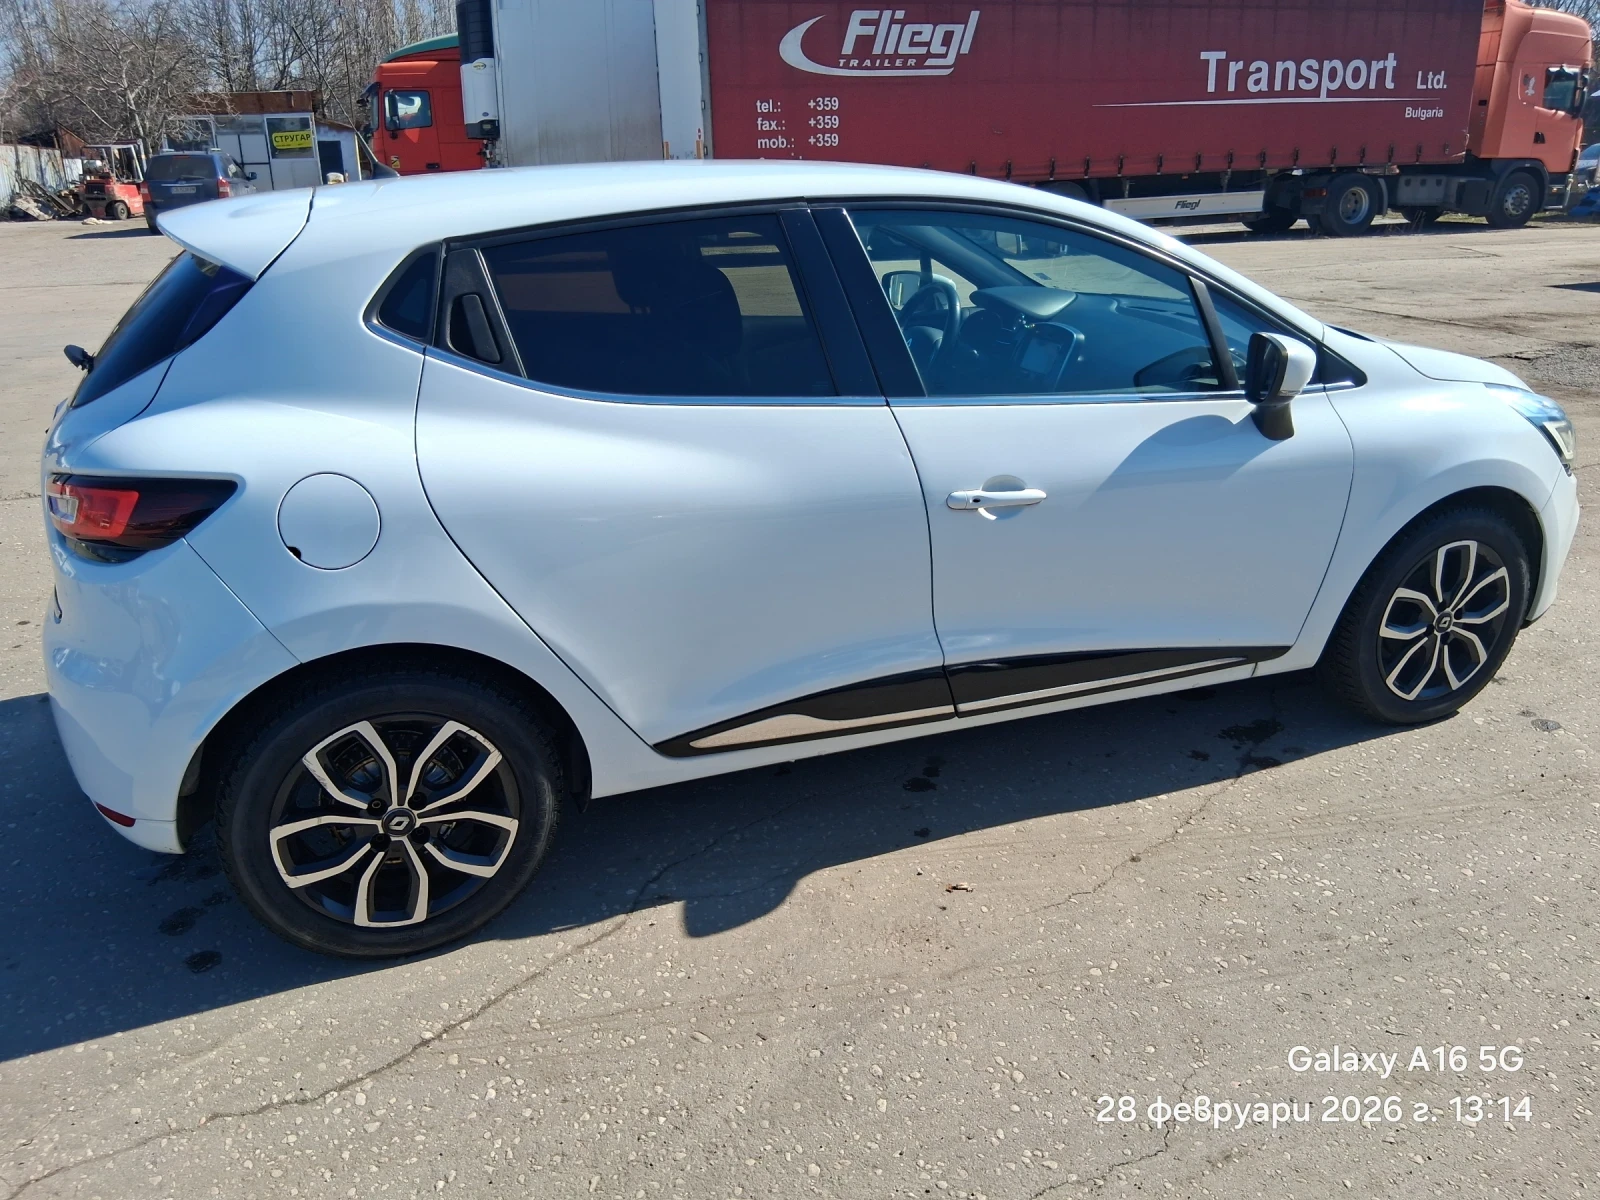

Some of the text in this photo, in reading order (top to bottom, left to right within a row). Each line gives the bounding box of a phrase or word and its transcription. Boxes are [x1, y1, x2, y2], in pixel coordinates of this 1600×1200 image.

[841, 10, 980, 66] Fliegl
[838, 58, 917, 67] TRAILER
[1200, 51, 1448, 98] Transport Ltd.
[756, 96, 839, 113] tel.: +359
[1404, 106, 1444, 121] Bulgaria
[757, 115, 840, 131] fax.: +359
[273, 133, 311, 143] СТРУГАР
[757, 133, 839, 149] mob.: +359
